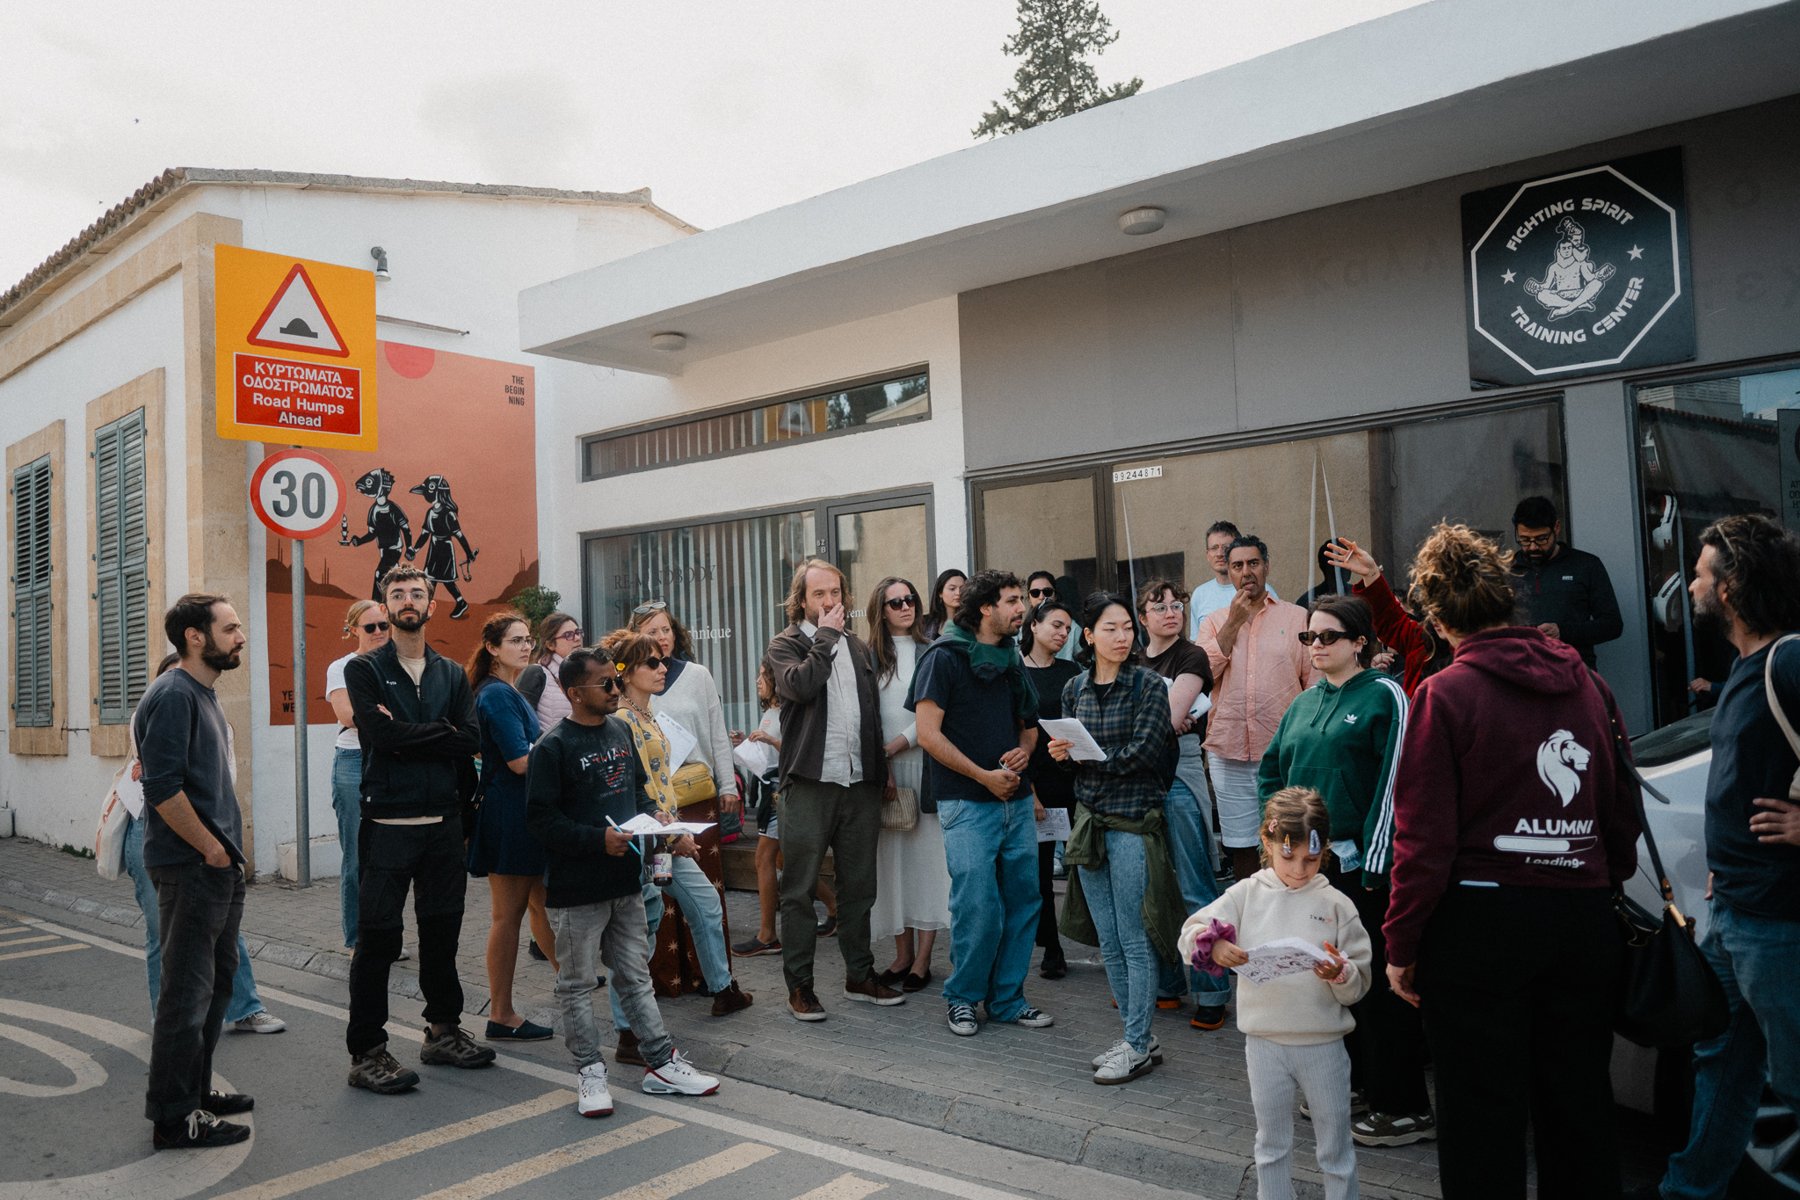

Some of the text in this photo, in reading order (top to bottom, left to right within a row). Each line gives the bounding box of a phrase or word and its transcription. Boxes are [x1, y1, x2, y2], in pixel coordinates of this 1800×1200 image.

[1506, 198, 1634, 251] FIGHTING SPIRIT
[1510, 277, 1645, 344] TRAINING CENTER
[254, 361, 342, 384] ΚΥΡΤΩΜΑΤΑ
[512, 375, 524, 385] THE
[242, 374, 354, 399] ΟΔΟΣΤΡΩΜΑΤΟΣ
[504, 384, 525, 396] BEGIN
[253, 392, 345, 415] Road Humps
[508, 395, 525, 406] NING
[278, 411, 322, 427] Ahead
[1114, 467, 1161, 482] 99244871
[272, 470, 326, 518] 30
[687, 625, 732, 644] hnique
[281, 690, 293, 701] YE
[1514, 818, 1594, 835] ALUMNI
